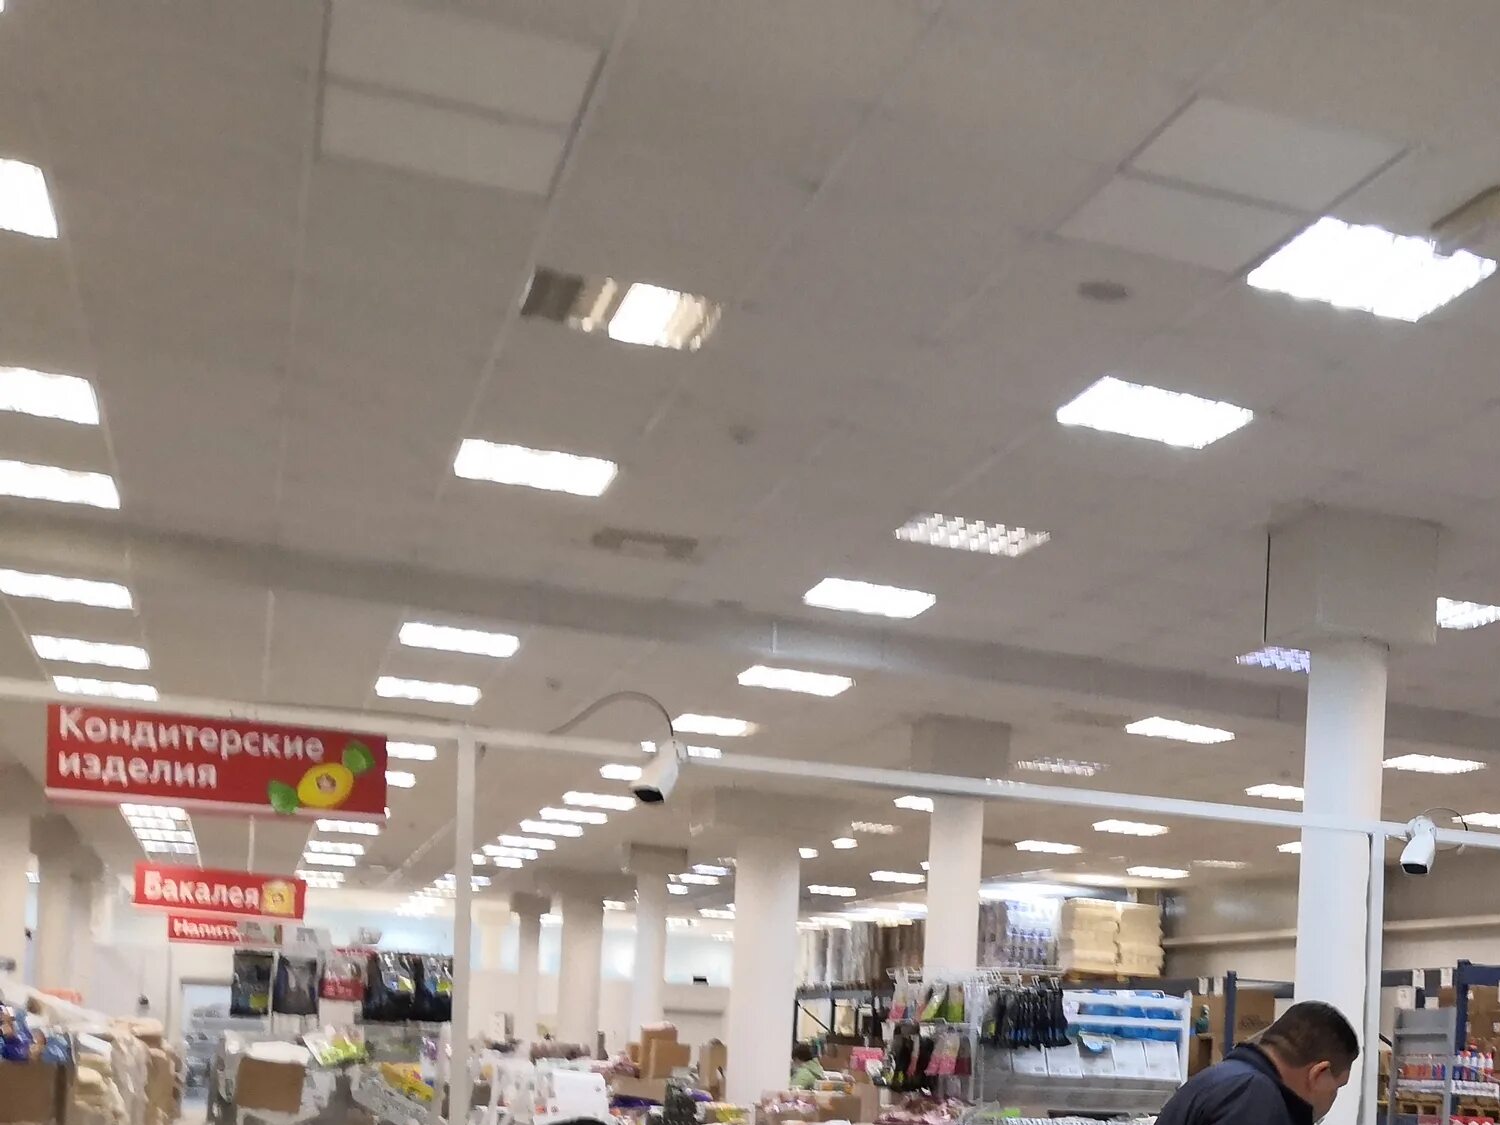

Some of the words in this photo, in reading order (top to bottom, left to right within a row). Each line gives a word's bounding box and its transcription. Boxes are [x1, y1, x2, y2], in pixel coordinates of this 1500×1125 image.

[58, 705, 324, 762] Кондитерские
[58, 751, 217, 789] изделия
[144, 870, 260, 911] Бакалея
